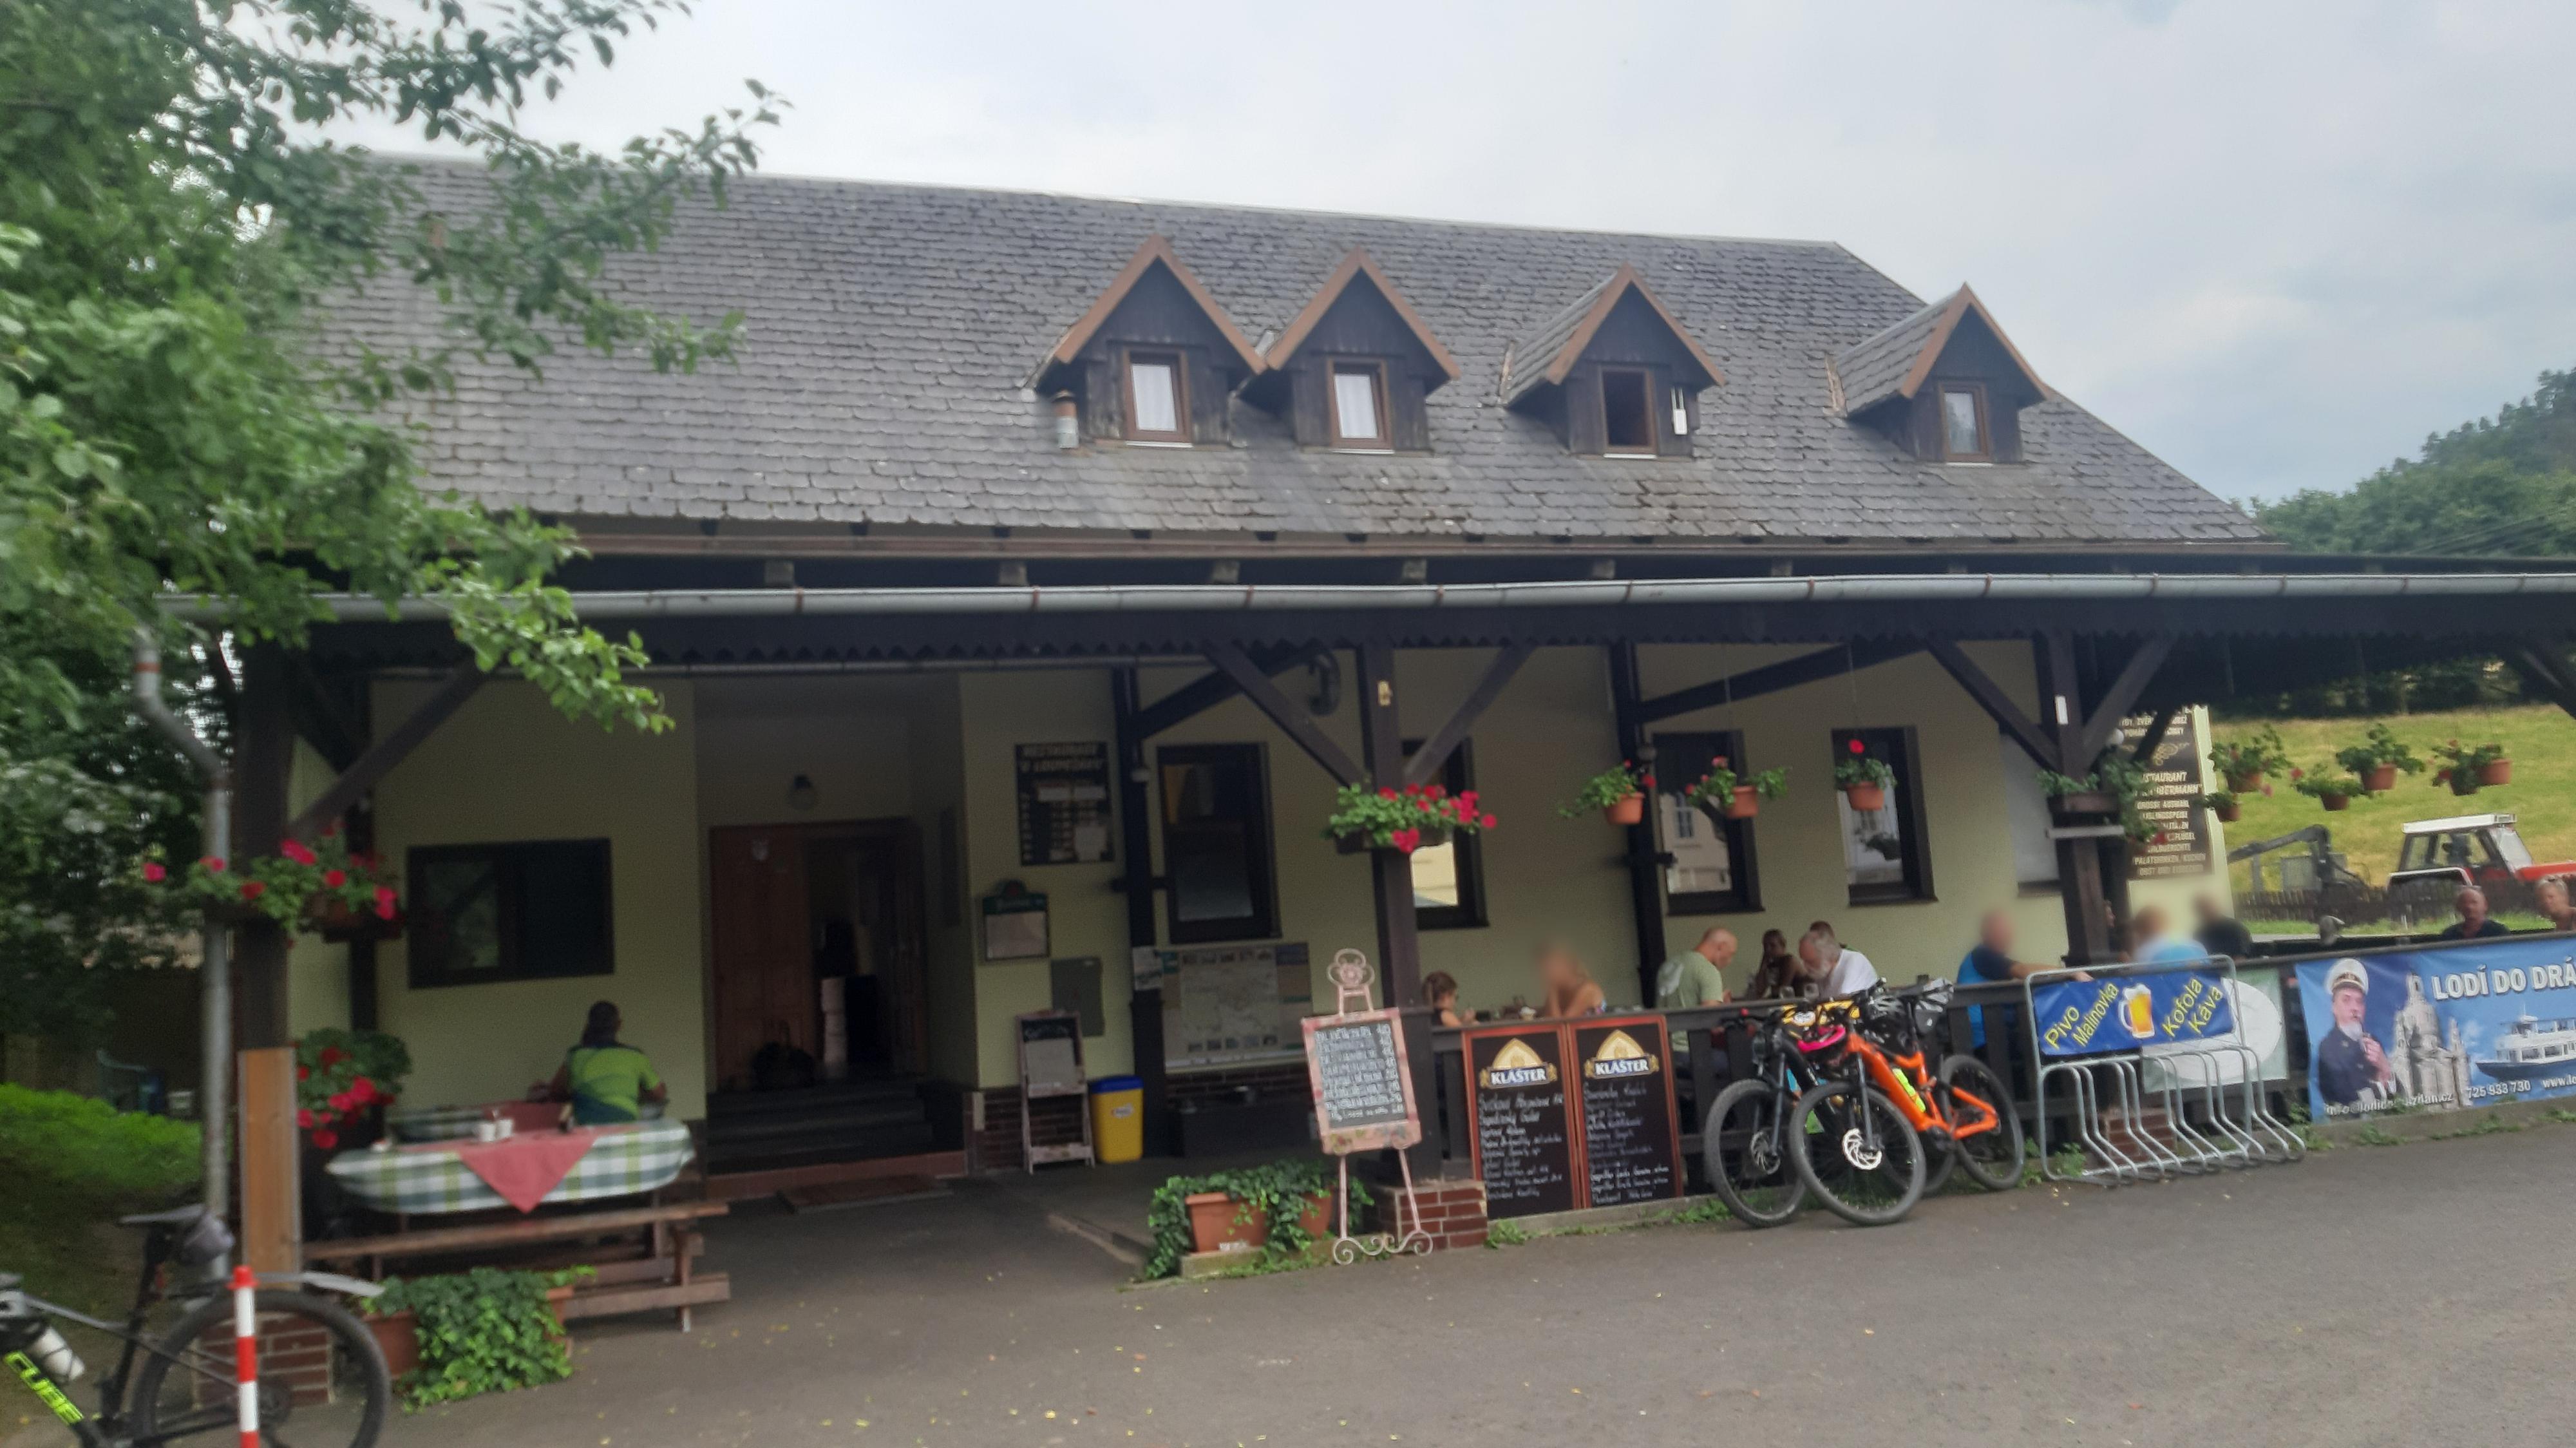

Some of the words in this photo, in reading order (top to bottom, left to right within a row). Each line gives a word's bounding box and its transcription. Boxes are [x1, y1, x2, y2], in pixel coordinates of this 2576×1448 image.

[2432, 964, 2489, 1000] LODÍ
[2492, 967, 2526, 995] DO
[2045, 1006, 2079, 1050] Pivo
[2070, 982, 2119, 1047] Malinovka
[2162, 978, 2202, 1037] Kofola
[2188, 986, 2223, 1034] Káva
[2466, 1086, 2486, 1099] 725
[2488, 1083, 2508, 1095] 933
[2510, 1080, 2531, 1092] 730
